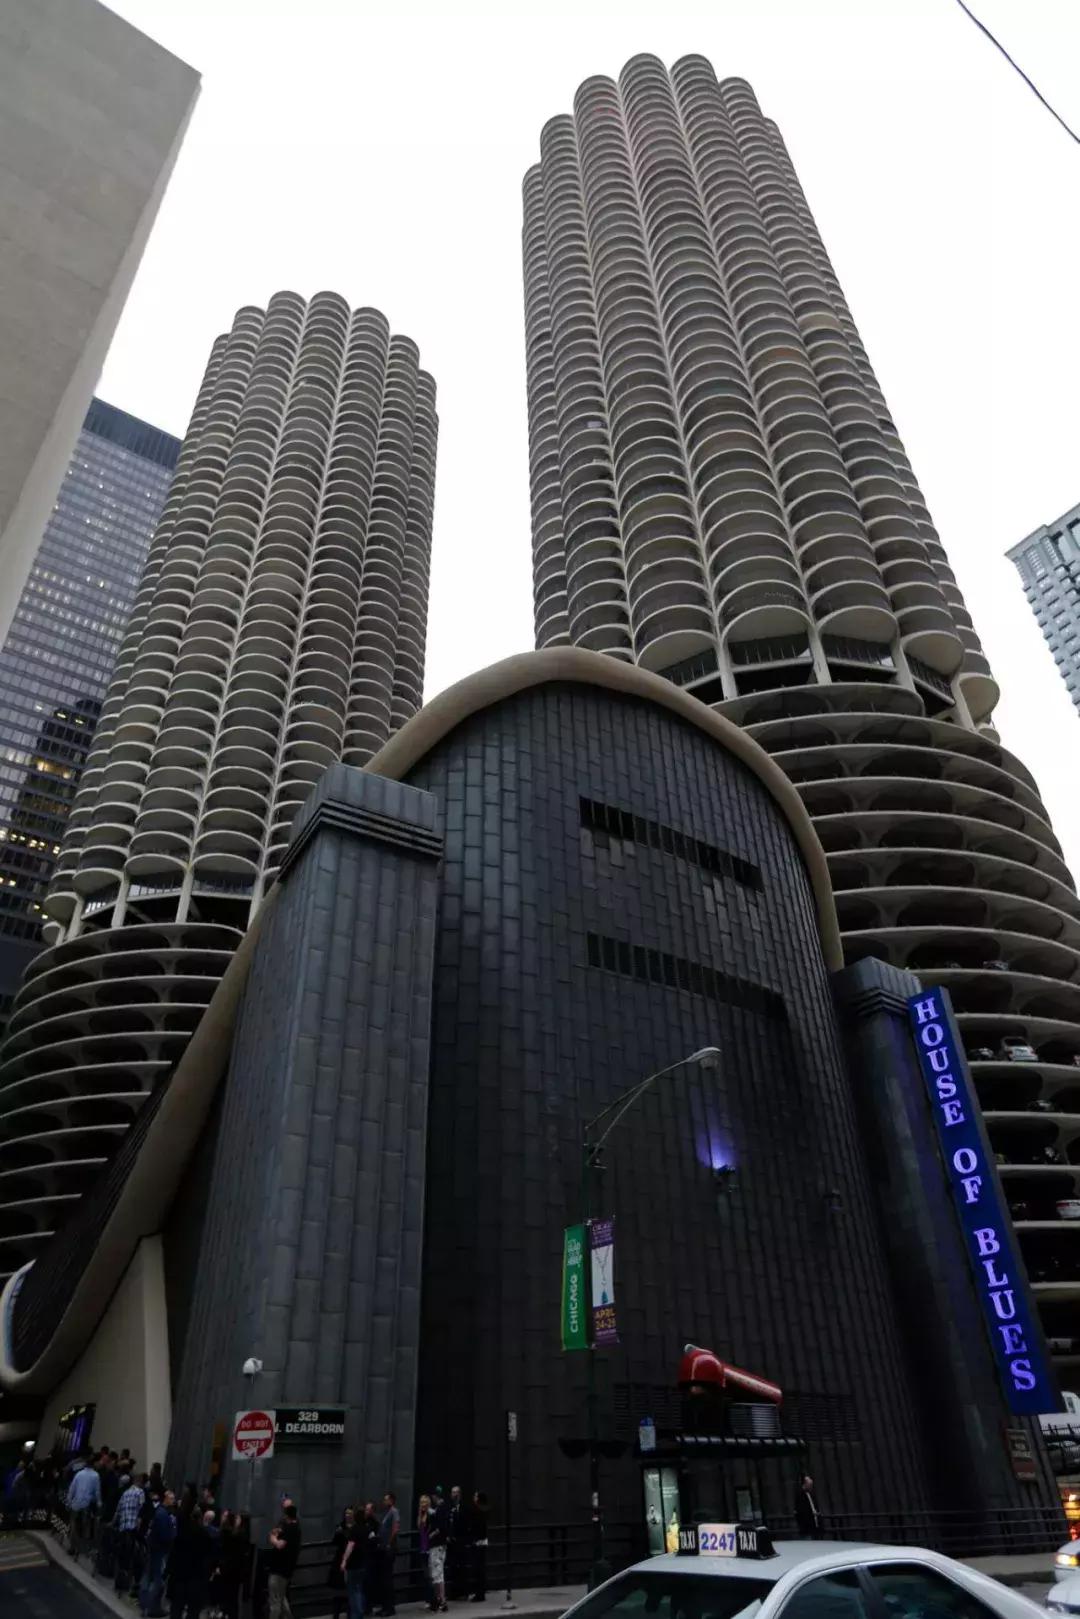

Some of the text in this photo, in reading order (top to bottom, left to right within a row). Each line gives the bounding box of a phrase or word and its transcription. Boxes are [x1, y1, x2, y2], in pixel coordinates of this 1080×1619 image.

[914, 997, 965, 1127] HOUSE
[953, 1148, 982, 1205] OF
[974, 1226, 1037, 1391] BLUES
[569, 1275, 579, 1333] CHICAGO
[595, 1307, 615, 1319] APRIL
[298, 1411, 319, 1421] 329
[241, 1419, 269, 1428] DO NOT
[286, 1423, 344, 1434] DEARBORN
[680, 1530, 757, 1551] TAXI 2247 TAXI
